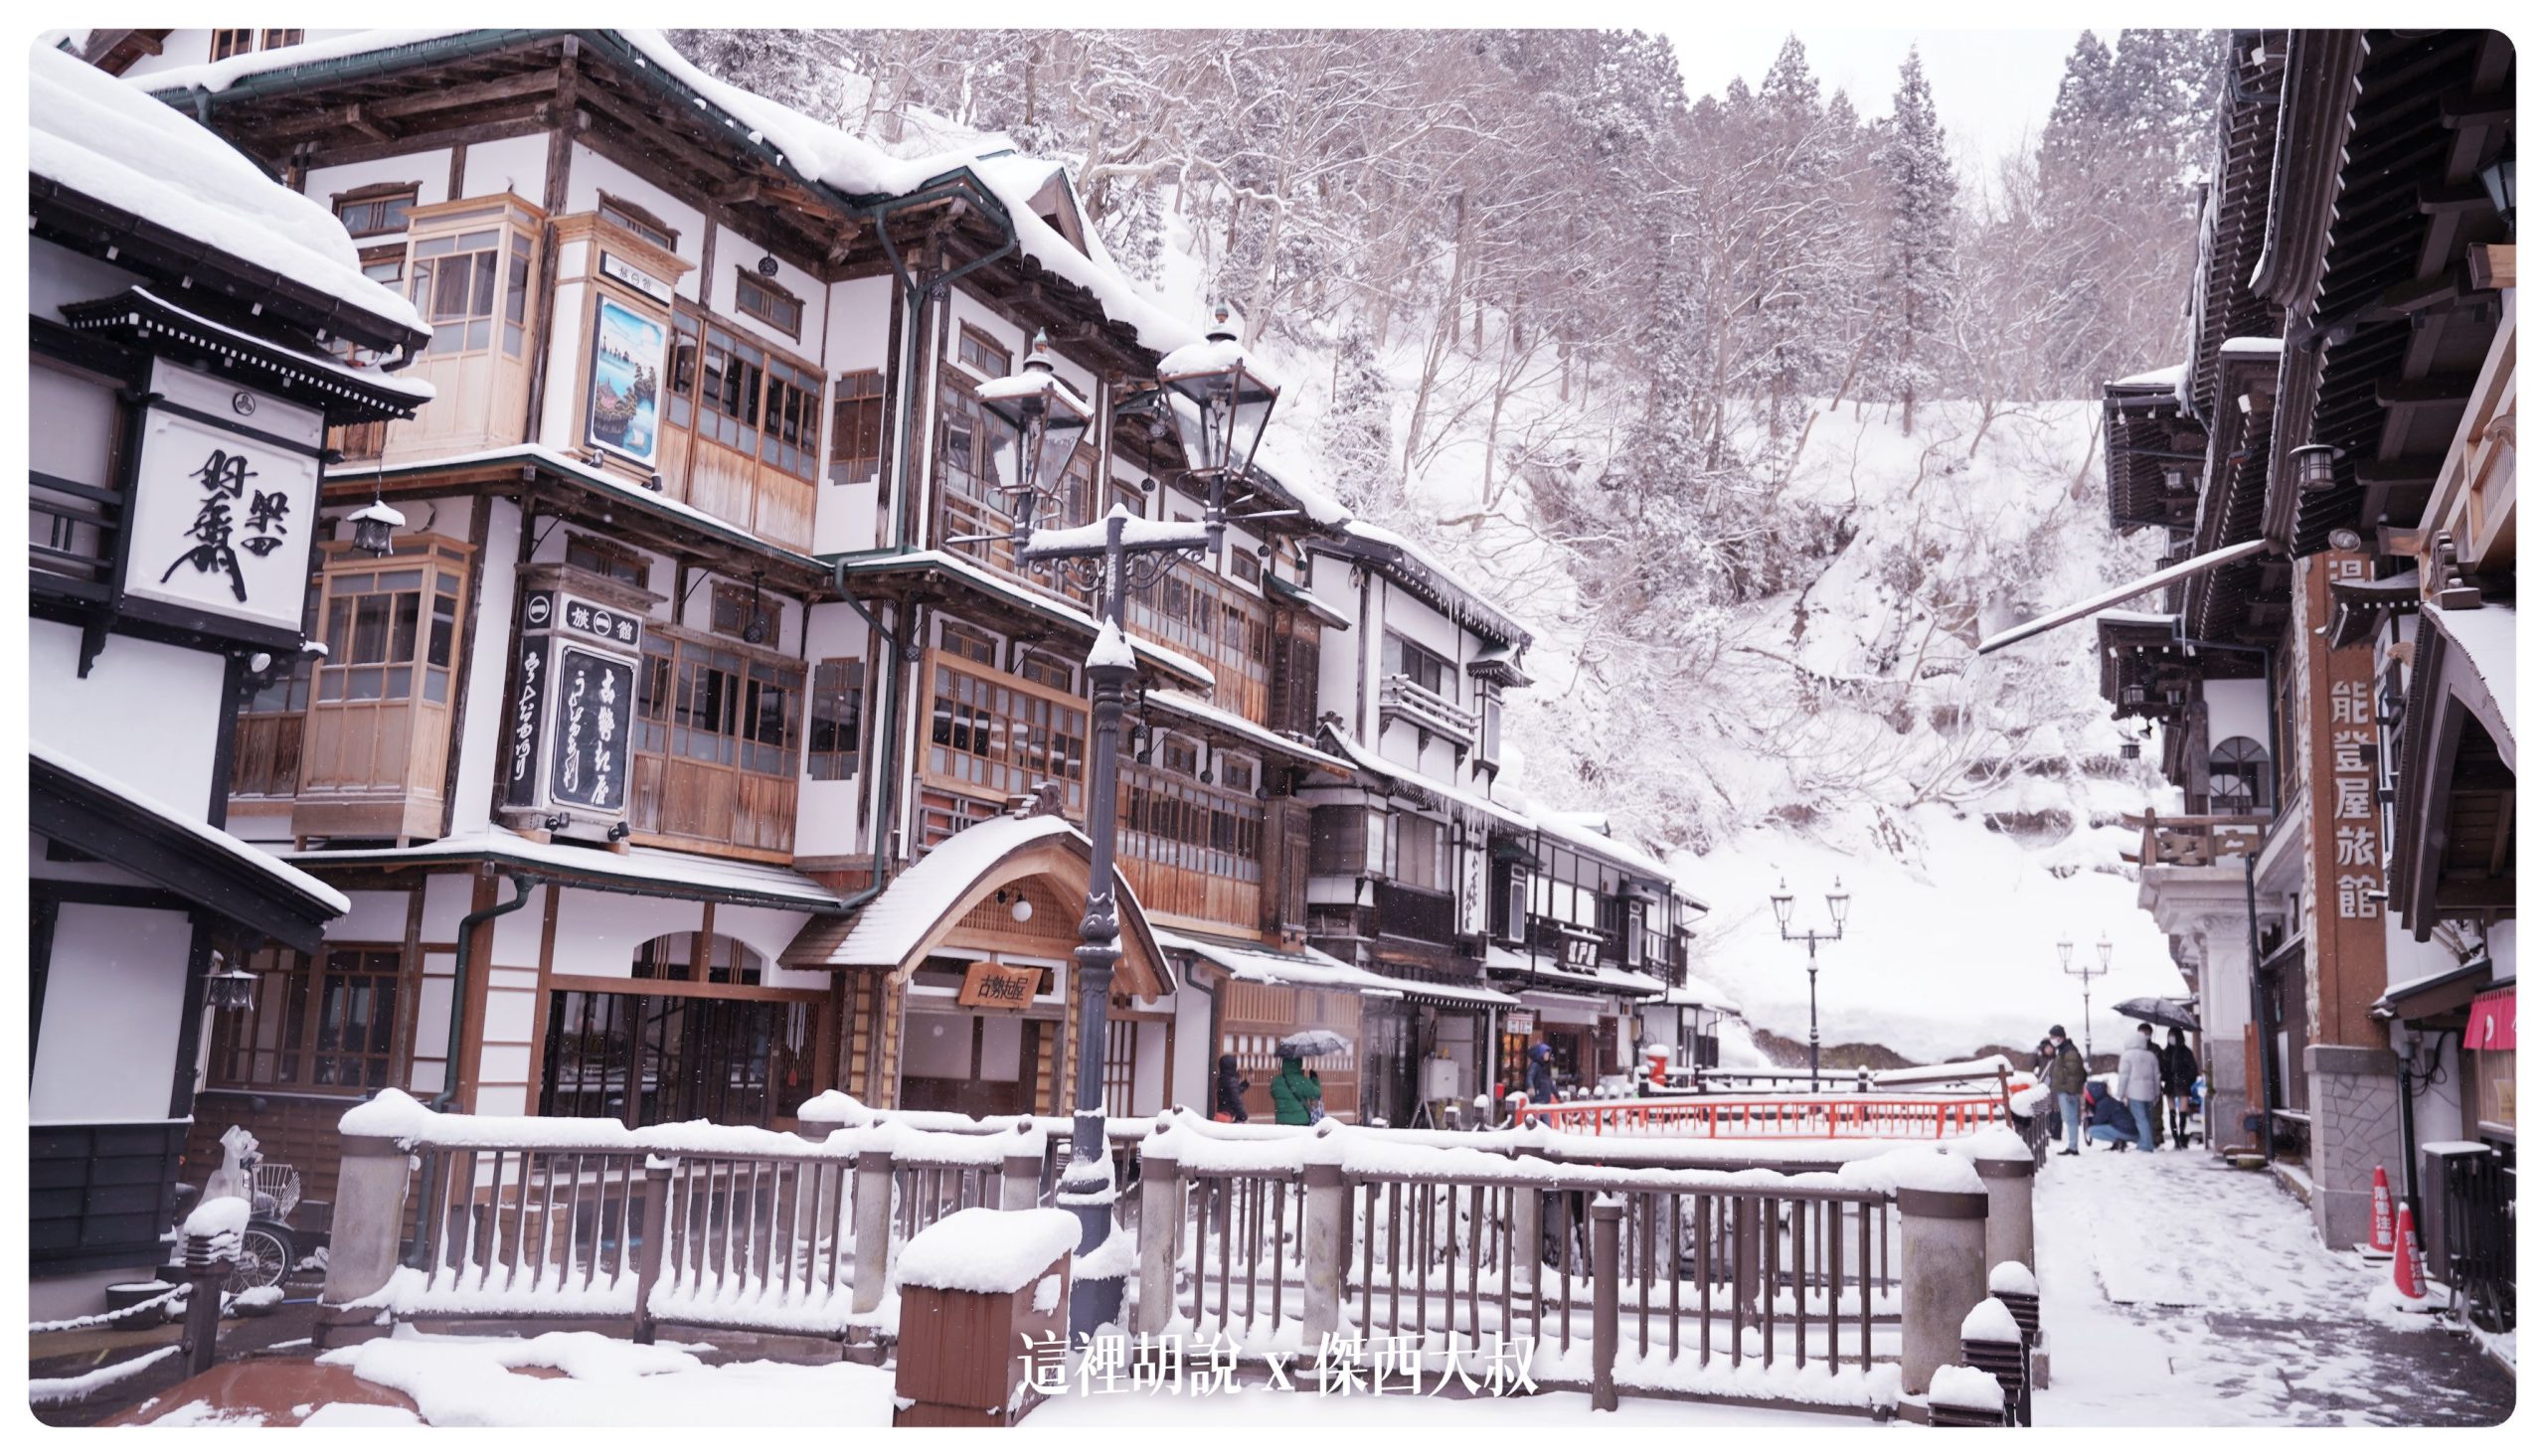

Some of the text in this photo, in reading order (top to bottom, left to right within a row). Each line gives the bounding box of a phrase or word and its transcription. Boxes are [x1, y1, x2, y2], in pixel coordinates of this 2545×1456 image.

[2330, 680, 2378, 919] 能登屋旅館
